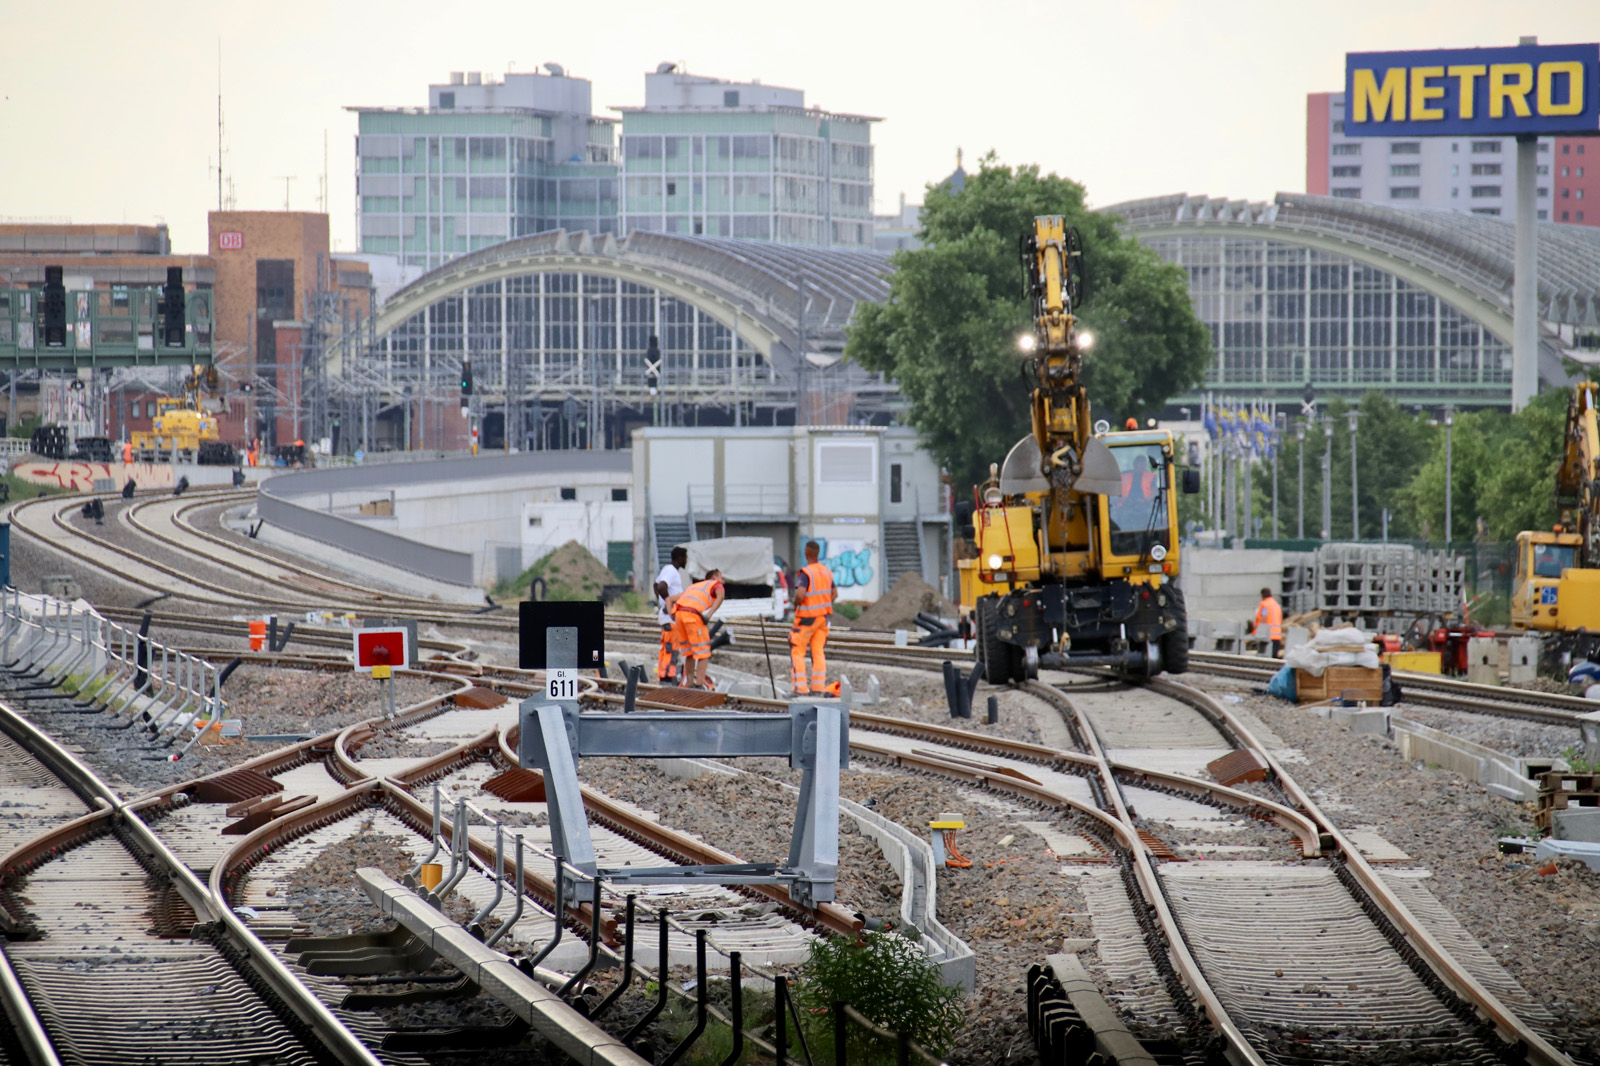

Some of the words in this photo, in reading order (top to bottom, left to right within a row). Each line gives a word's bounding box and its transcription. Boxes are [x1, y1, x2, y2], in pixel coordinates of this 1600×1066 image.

[1352, 61, 1584, 123] METRO
[222, 234, 240, 247] DB
[550, 679, 574, 697] 611
